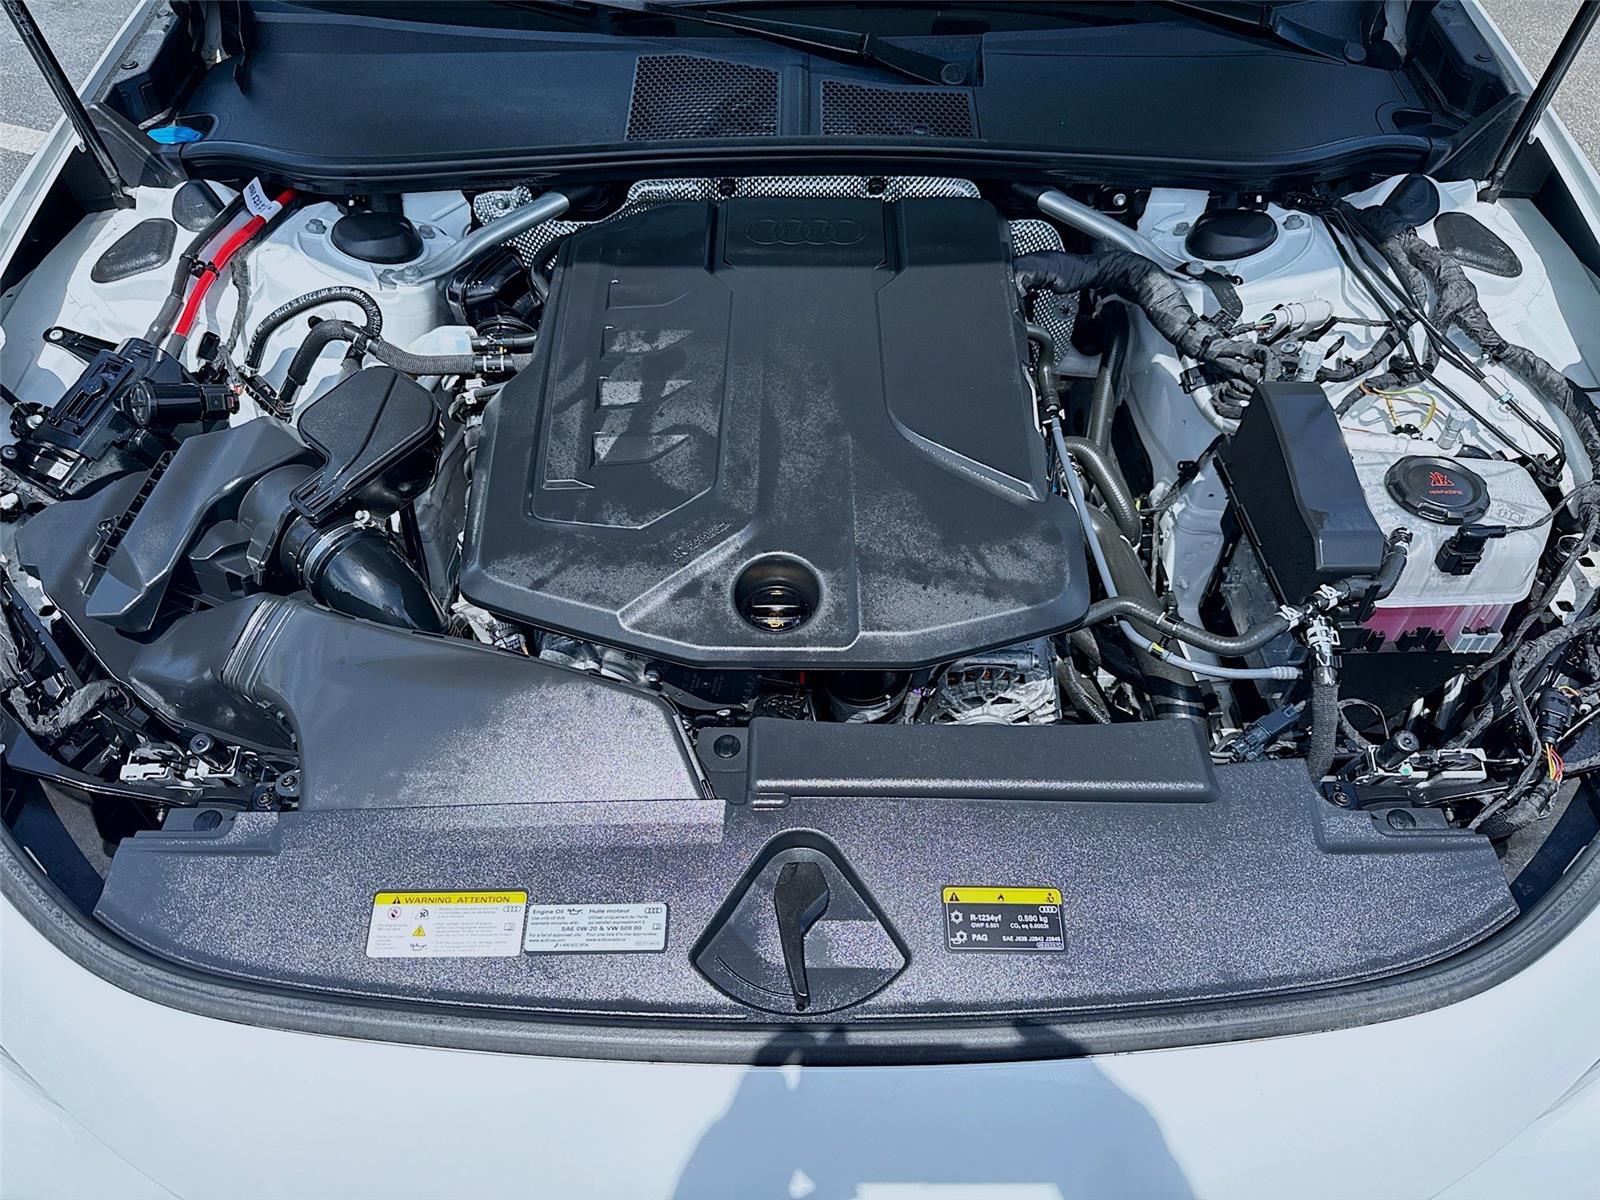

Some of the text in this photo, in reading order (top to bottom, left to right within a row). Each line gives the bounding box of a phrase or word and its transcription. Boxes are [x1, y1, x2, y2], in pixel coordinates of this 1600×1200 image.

[405, 896, 510, 904] WARNING ATTENTION
[970, 914, 1002, 922] R-1234yf
[1039, 914, 1048, 923] kg
